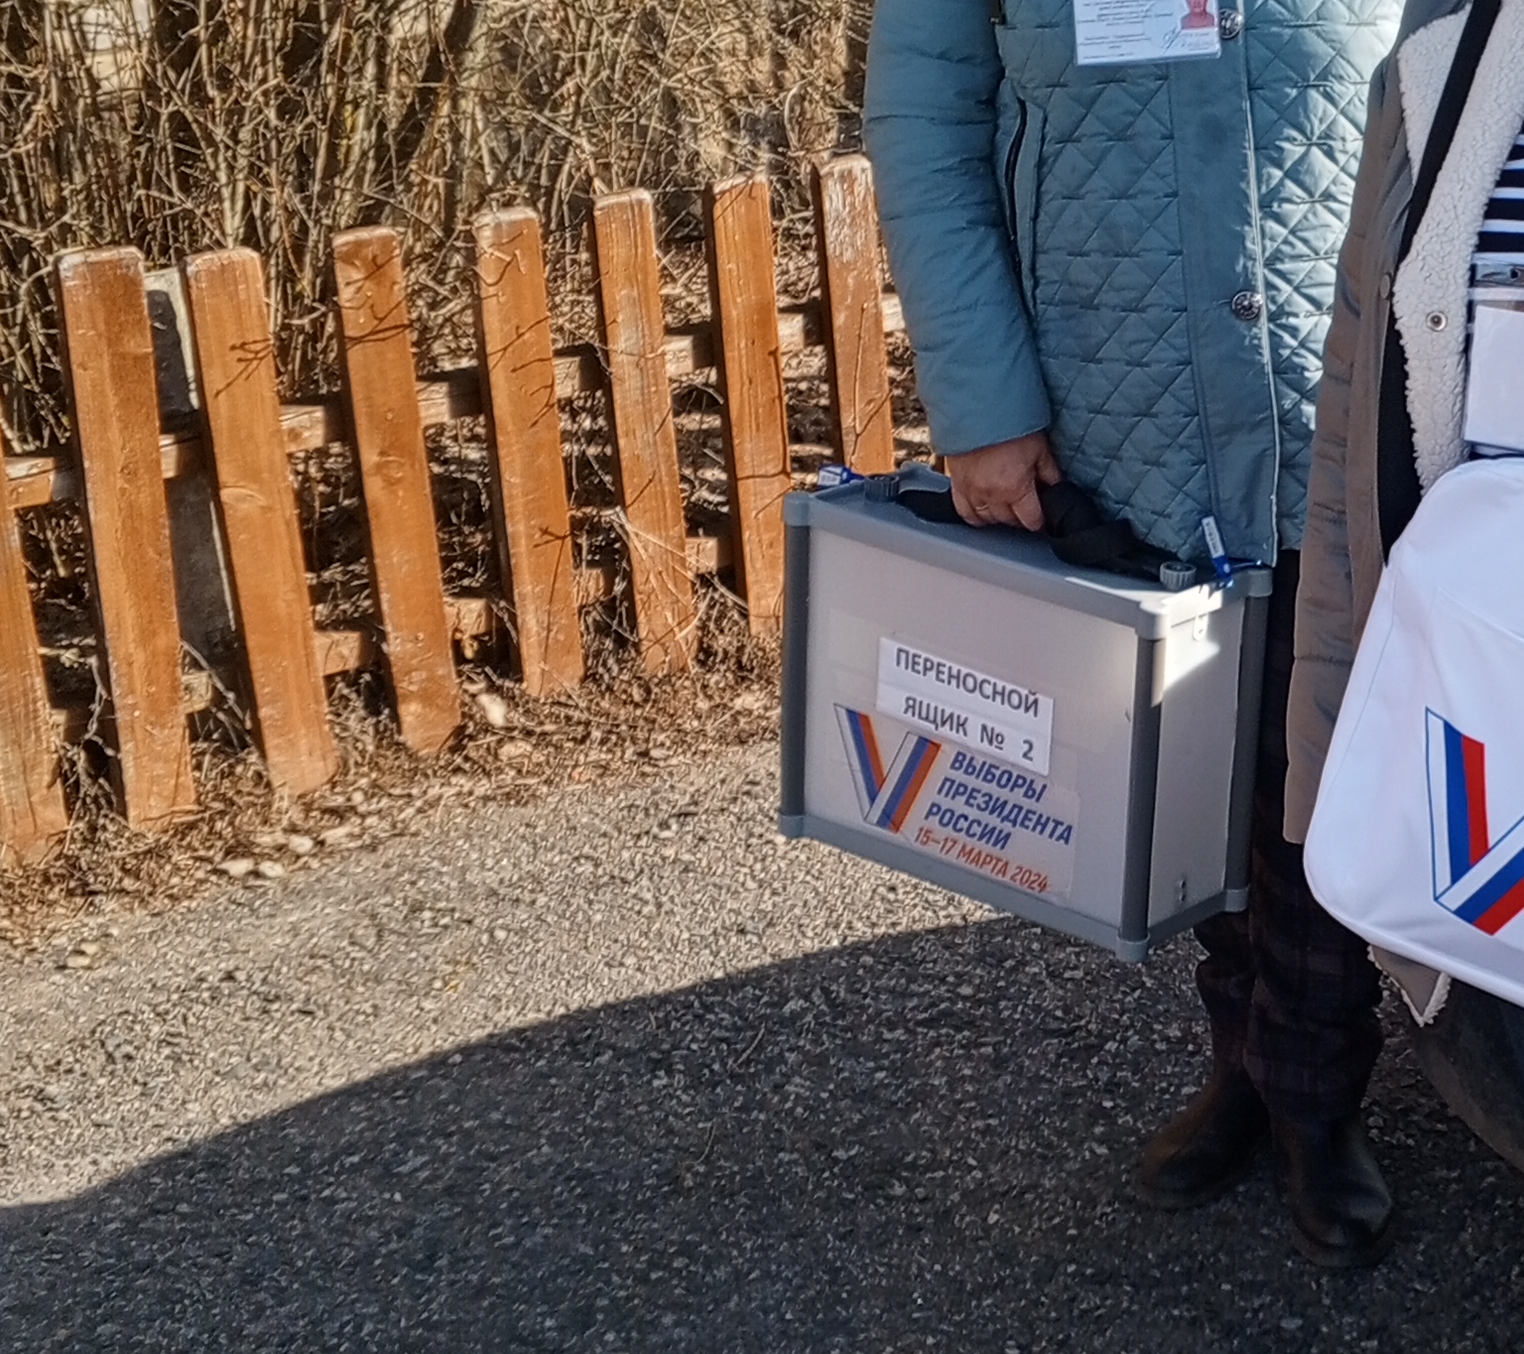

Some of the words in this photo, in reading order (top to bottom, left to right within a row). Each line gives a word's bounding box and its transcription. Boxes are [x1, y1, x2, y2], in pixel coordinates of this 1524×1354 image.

[896, 647, 1040, 718] ПЕРЕНОСНОЙ
[903, 696, 969, 737] ЯЩИК
[980, 723, 1005, 751] №
[1021, 739, 1035, 762] 2
[949, 750, 1047, 803] ВЫБОРЫ
[924, 802, 1012, 851] РОССИИ
[936, 776, 1073, 845] ПРЕЗИДЕНТА
[955, 844, 1009, 879] МАРТА
[1009, 865, 1050, 894] 2024
